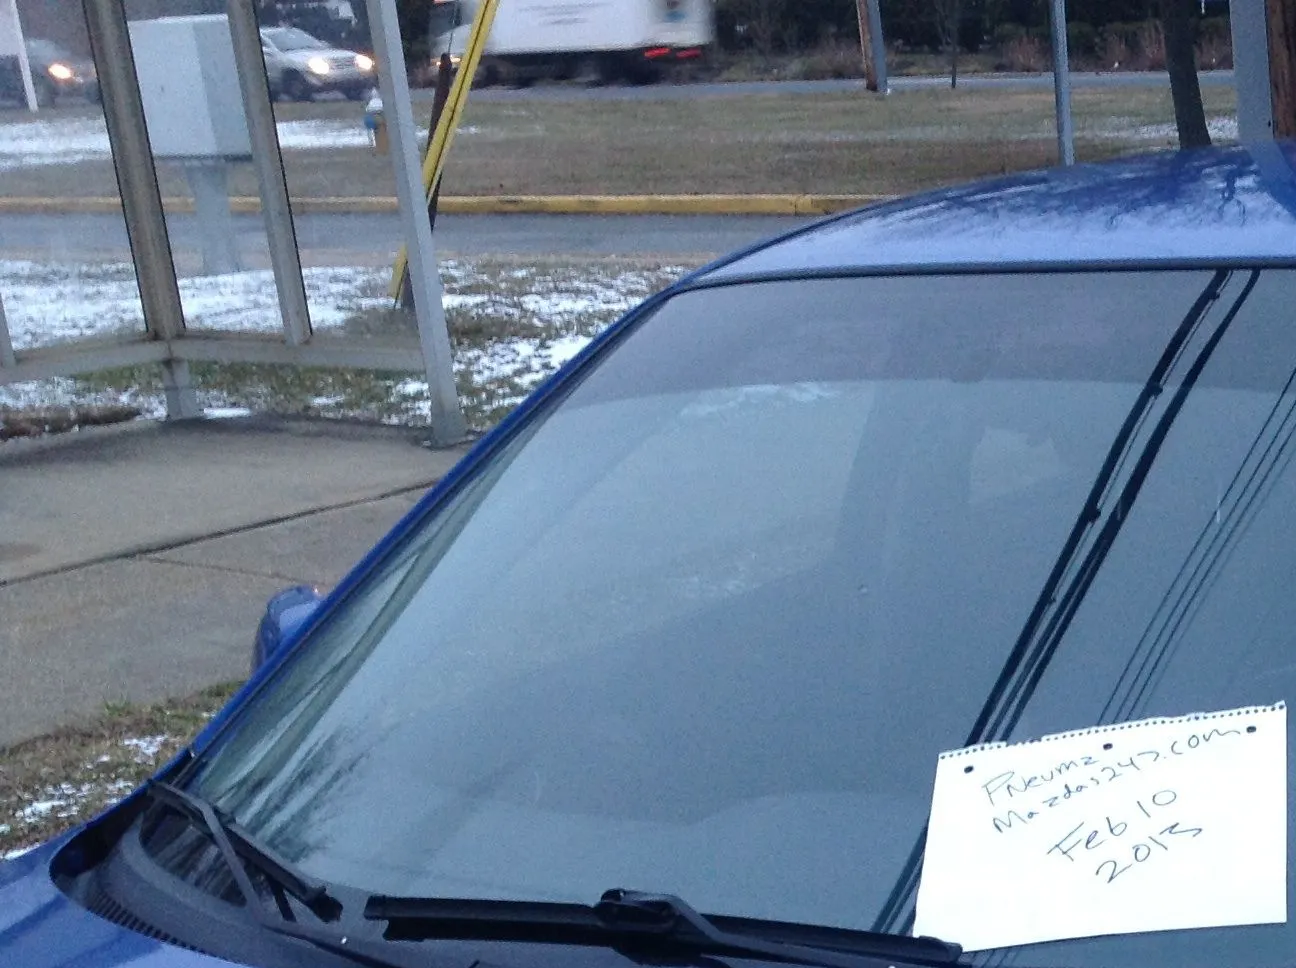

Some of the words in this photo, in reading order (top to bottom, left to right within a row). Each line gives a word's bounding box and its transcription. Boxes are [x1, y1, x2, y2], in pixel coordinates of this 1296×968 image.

[1046, 817, 1128, 862] Feb
[1137, 790, 1178, 818] 10
[1096, 822, 1203, 884] 2015
